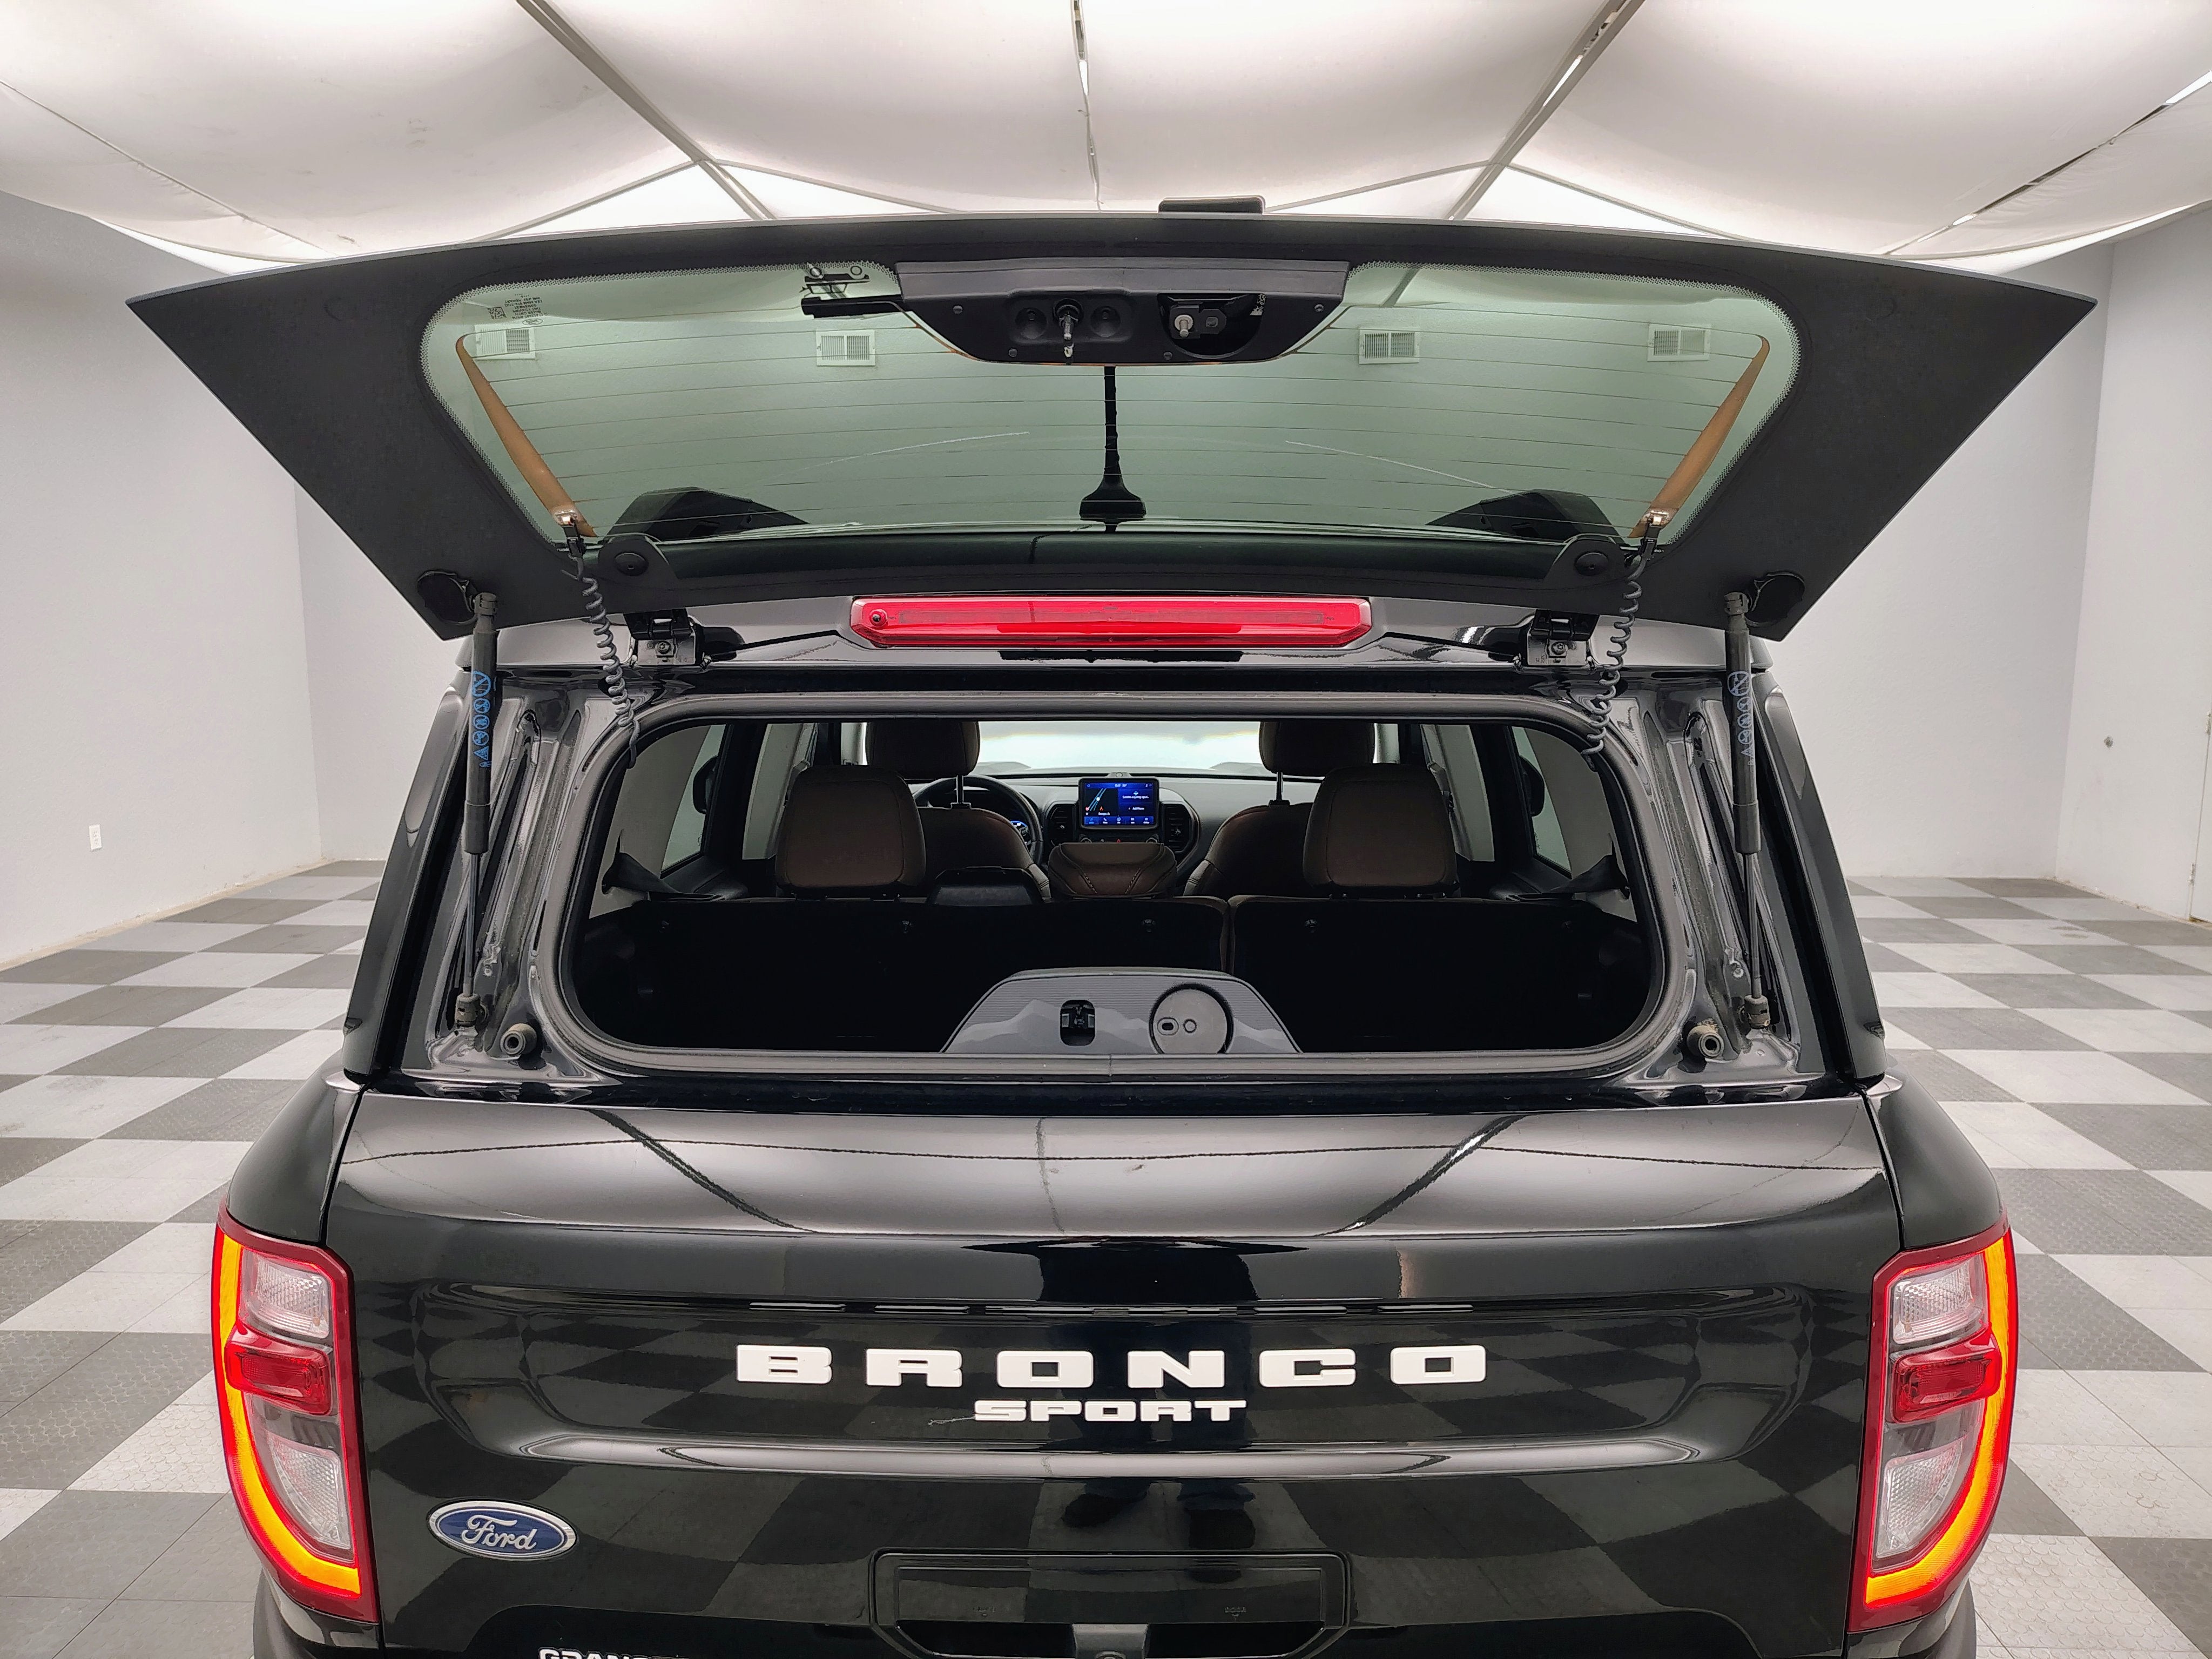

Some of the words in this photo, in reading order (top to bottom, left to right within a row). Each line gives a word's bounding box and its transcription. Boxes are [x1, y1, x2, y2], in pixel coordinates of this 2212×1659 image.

[736, 1344, 1486, 1388] BRONCO
[974, 1400, 1246, 1422] SPORT
[461, 1515, 538, 1550] Ford
